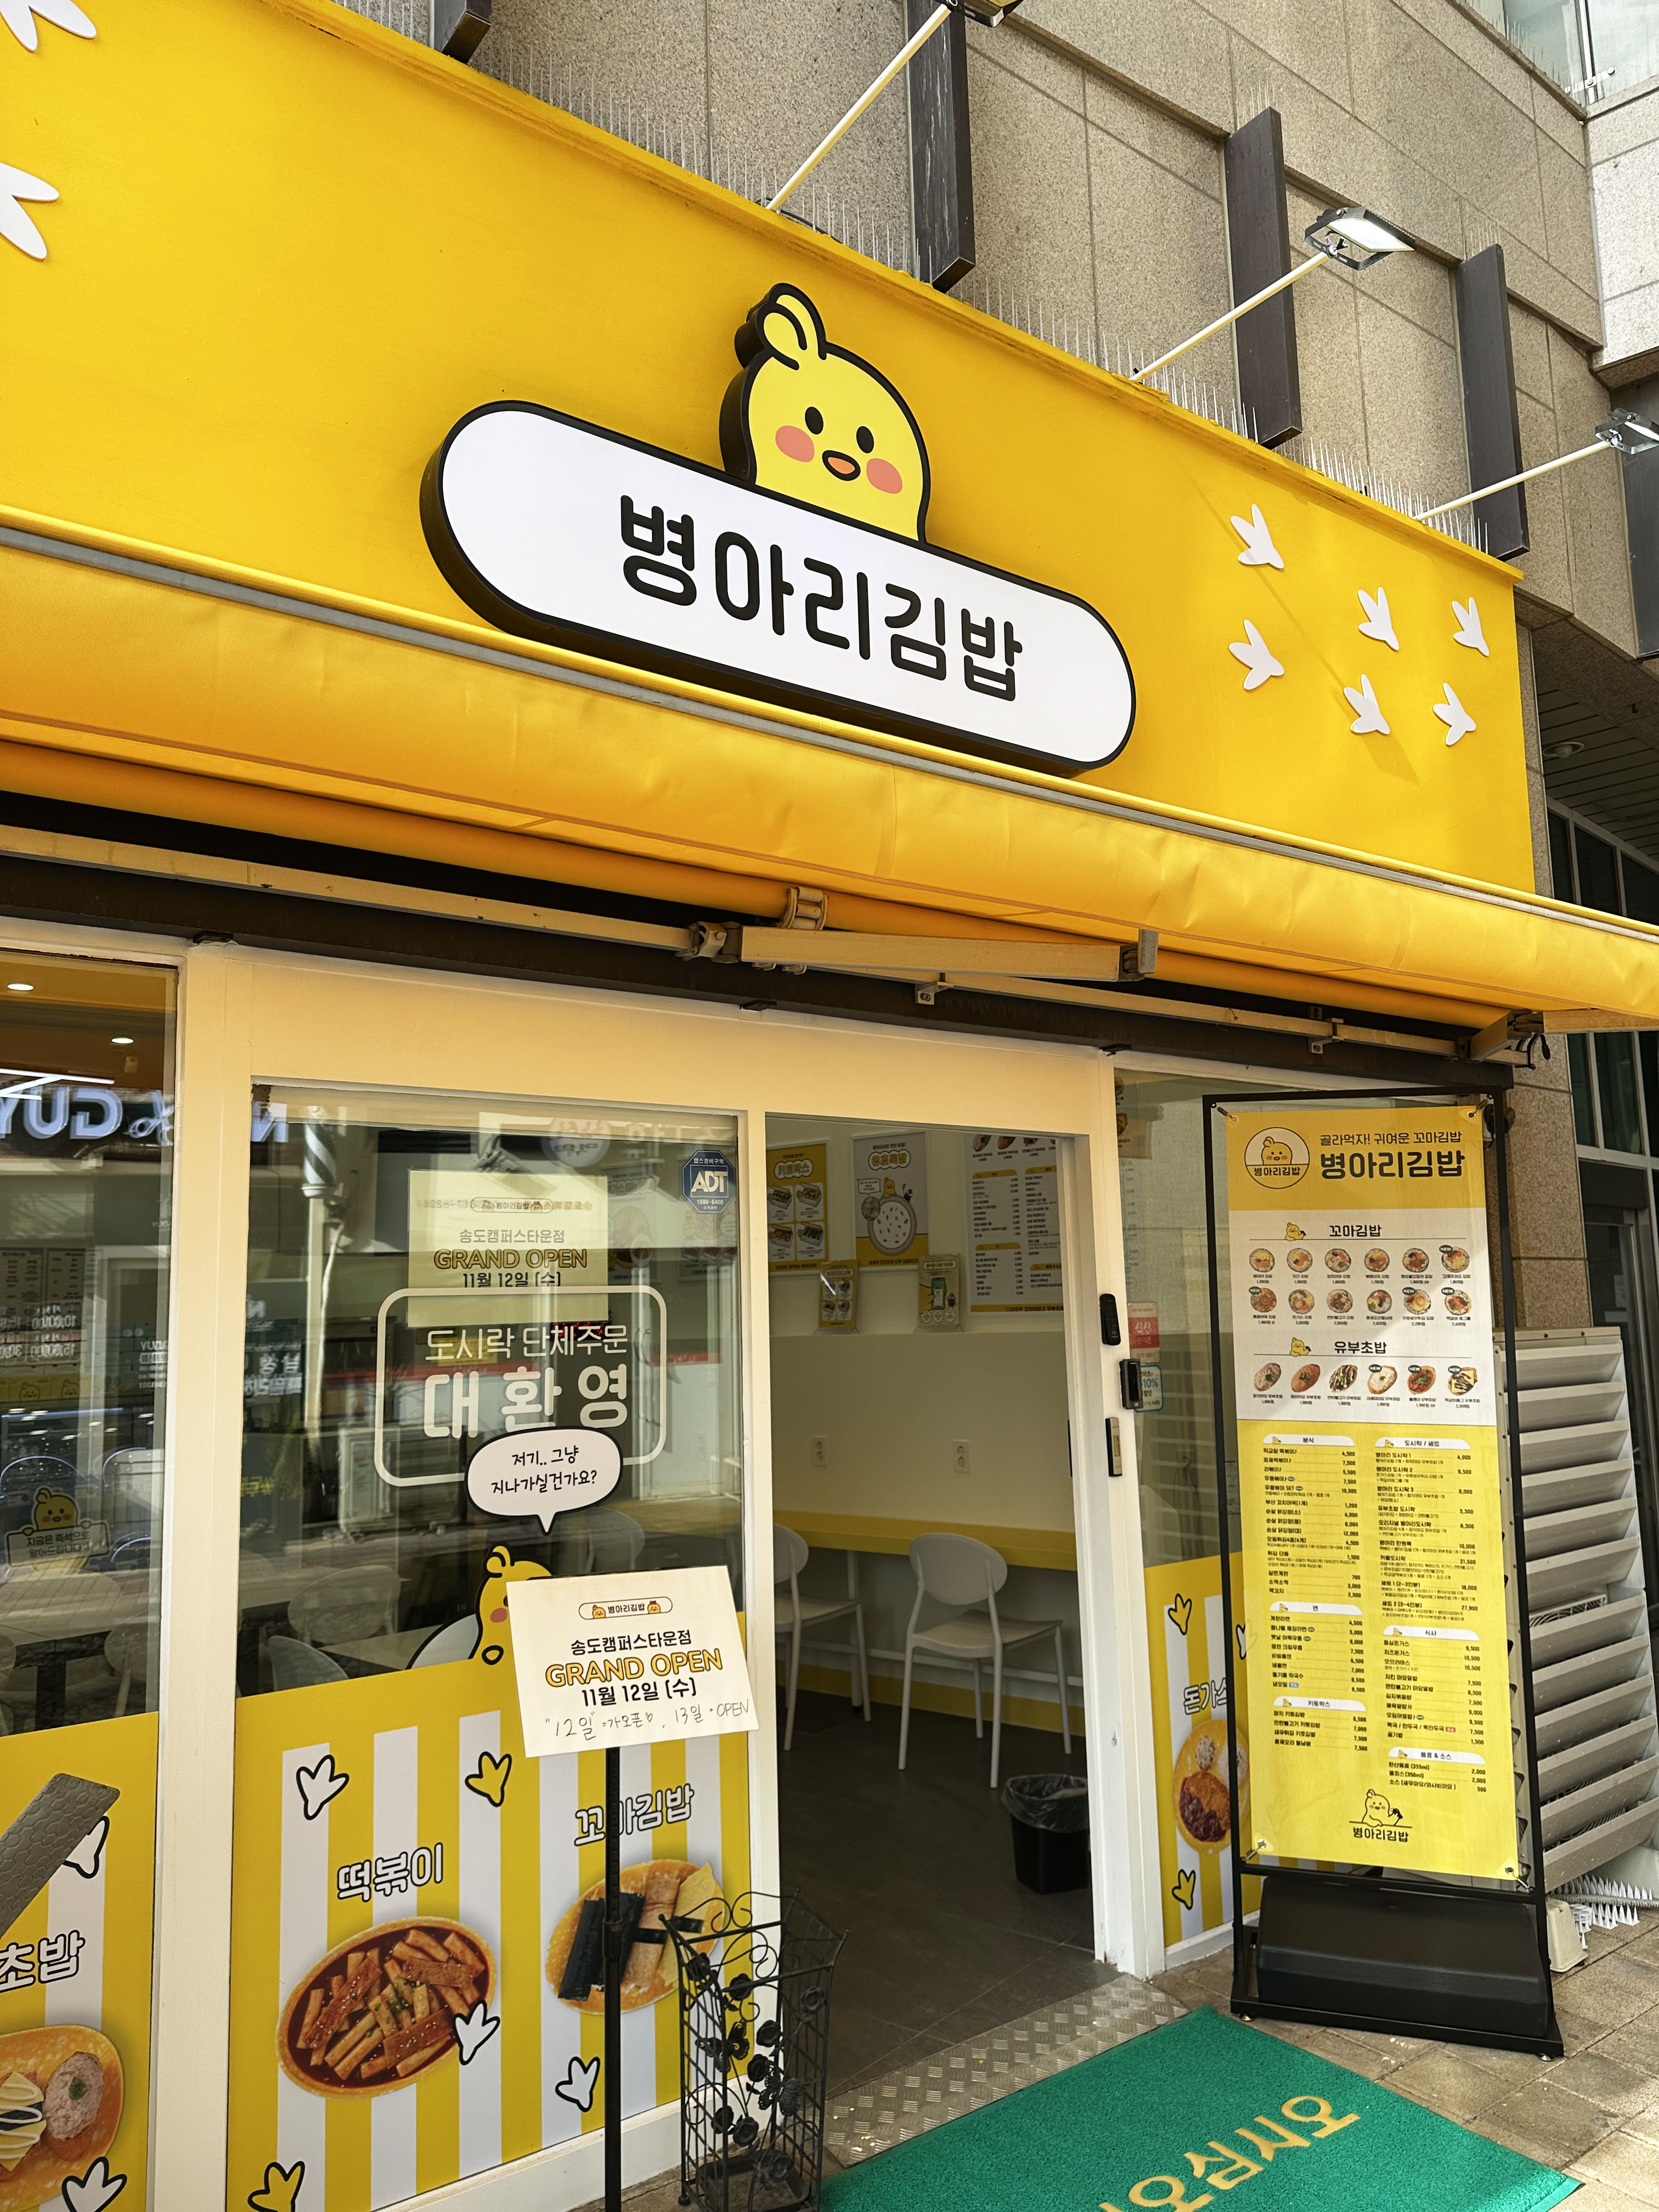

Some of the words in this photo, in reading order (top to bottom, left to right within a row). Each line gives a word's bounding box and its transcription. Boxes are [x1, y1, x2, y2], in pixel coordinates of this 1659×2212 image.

[620, 494, 1023, 702] 병아리김밥
[1320, 1133, 1370, 1146] 골라먹자!
[1374, 1132, 1410, 1145] 귀여운
[1413, 1131, 1462, 1144] 꼬마김밥
[1254, 1166, 1301, 1177] 병아리김밥
[1321, 1150, 1465, 1180] 병아리김밥
[691, 1171, 728, 1193] ADT
[459, 1229, 565, 1244] 송도캠퍼스타운점
[1329, 1224, 1382, 1238] 꼬마김밥
[434, 1249, 520, 1269] GRAND
[525, 1248, 588, 1269] OPEN
[463, 1273, 492, 1287] 11월
[498, 1273, 529, 1287] 12일
[426, 1327, 515, 1360] 도시락
[523, 1325, 628, 1358] 단체주문
[1334, 1341, 1387, 1354] 유부초밥
[552, 1446, 579, 1465] 그냥
[491, 1470, 597, 1496] 지나가실건가요?
[607, 1602, 645, 1615] 병아리김밥
[571, 1630, 691, 1656] 송도캠퍼스타운점
[545, 1656, 645, 1688] GRAND
[650, 1648, 723, 1677] OPEN
[582, 1686, 616, 1707] 11월
[623, 1680, 660, 1703] 12일
[1183, 1678, 1228, 1715] 돈가스
[675, 1703, 704, 1725] 13일
[1353, 1826, 1409, 1843] 병아리김밥
[337, 1843, 444, 1902] 떡볶이
[0, 1929, 86, 1993] 초밥
[1099, 2096, 1360, 2212] 오십시오
